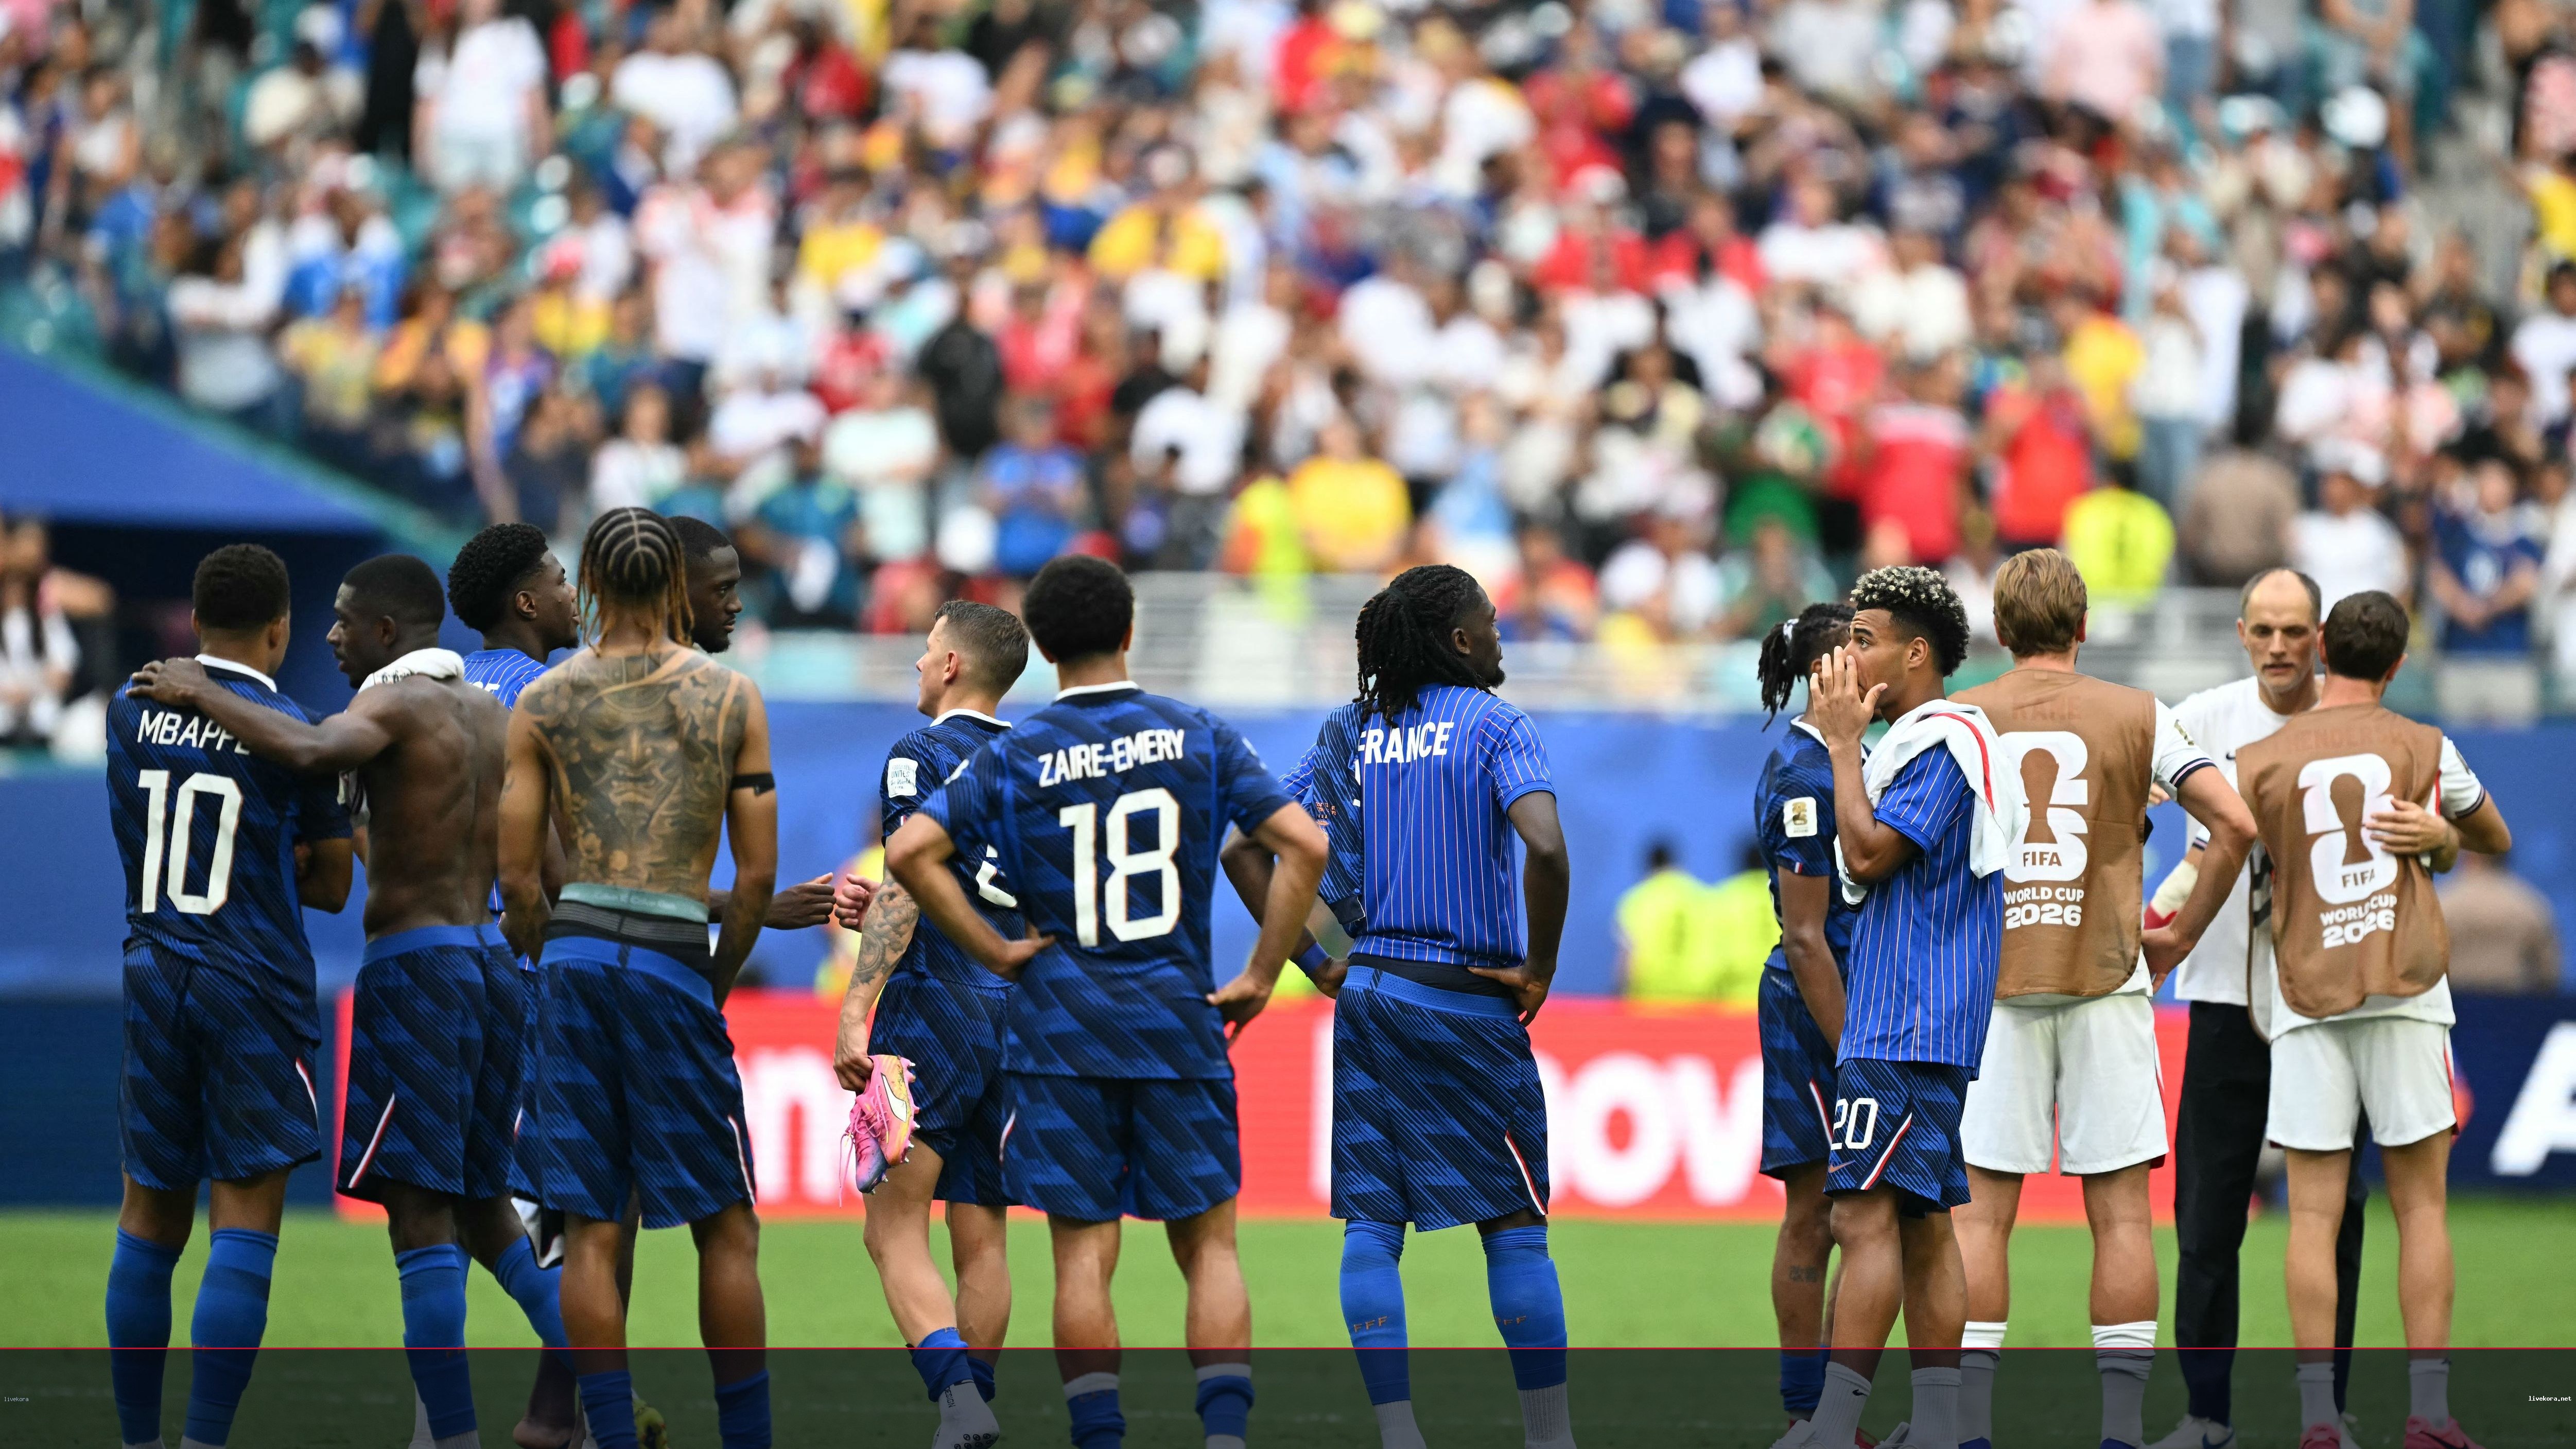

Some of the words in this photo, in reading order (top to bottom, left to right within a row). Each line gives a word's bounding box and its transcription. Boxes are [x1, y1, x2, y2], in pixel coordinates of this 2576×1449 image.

[1037, 728, 1184, 788] ZAIRE-EMERY
[138, 770, 242, 915] 10
[2023, 851, 2062, 867] FIFA
[1059, 788, 1180, 948] 18
[2004, 886, 2052, 905] WORLD
[2055, 887, 2084, 902] CUP
[2370, 894, 2397, 910] CUP
[2005, 903, 2082, 930] 2026
[2322, 909, 2395, 950] 2026
[1831, 1097, 1879, 1149] 20
